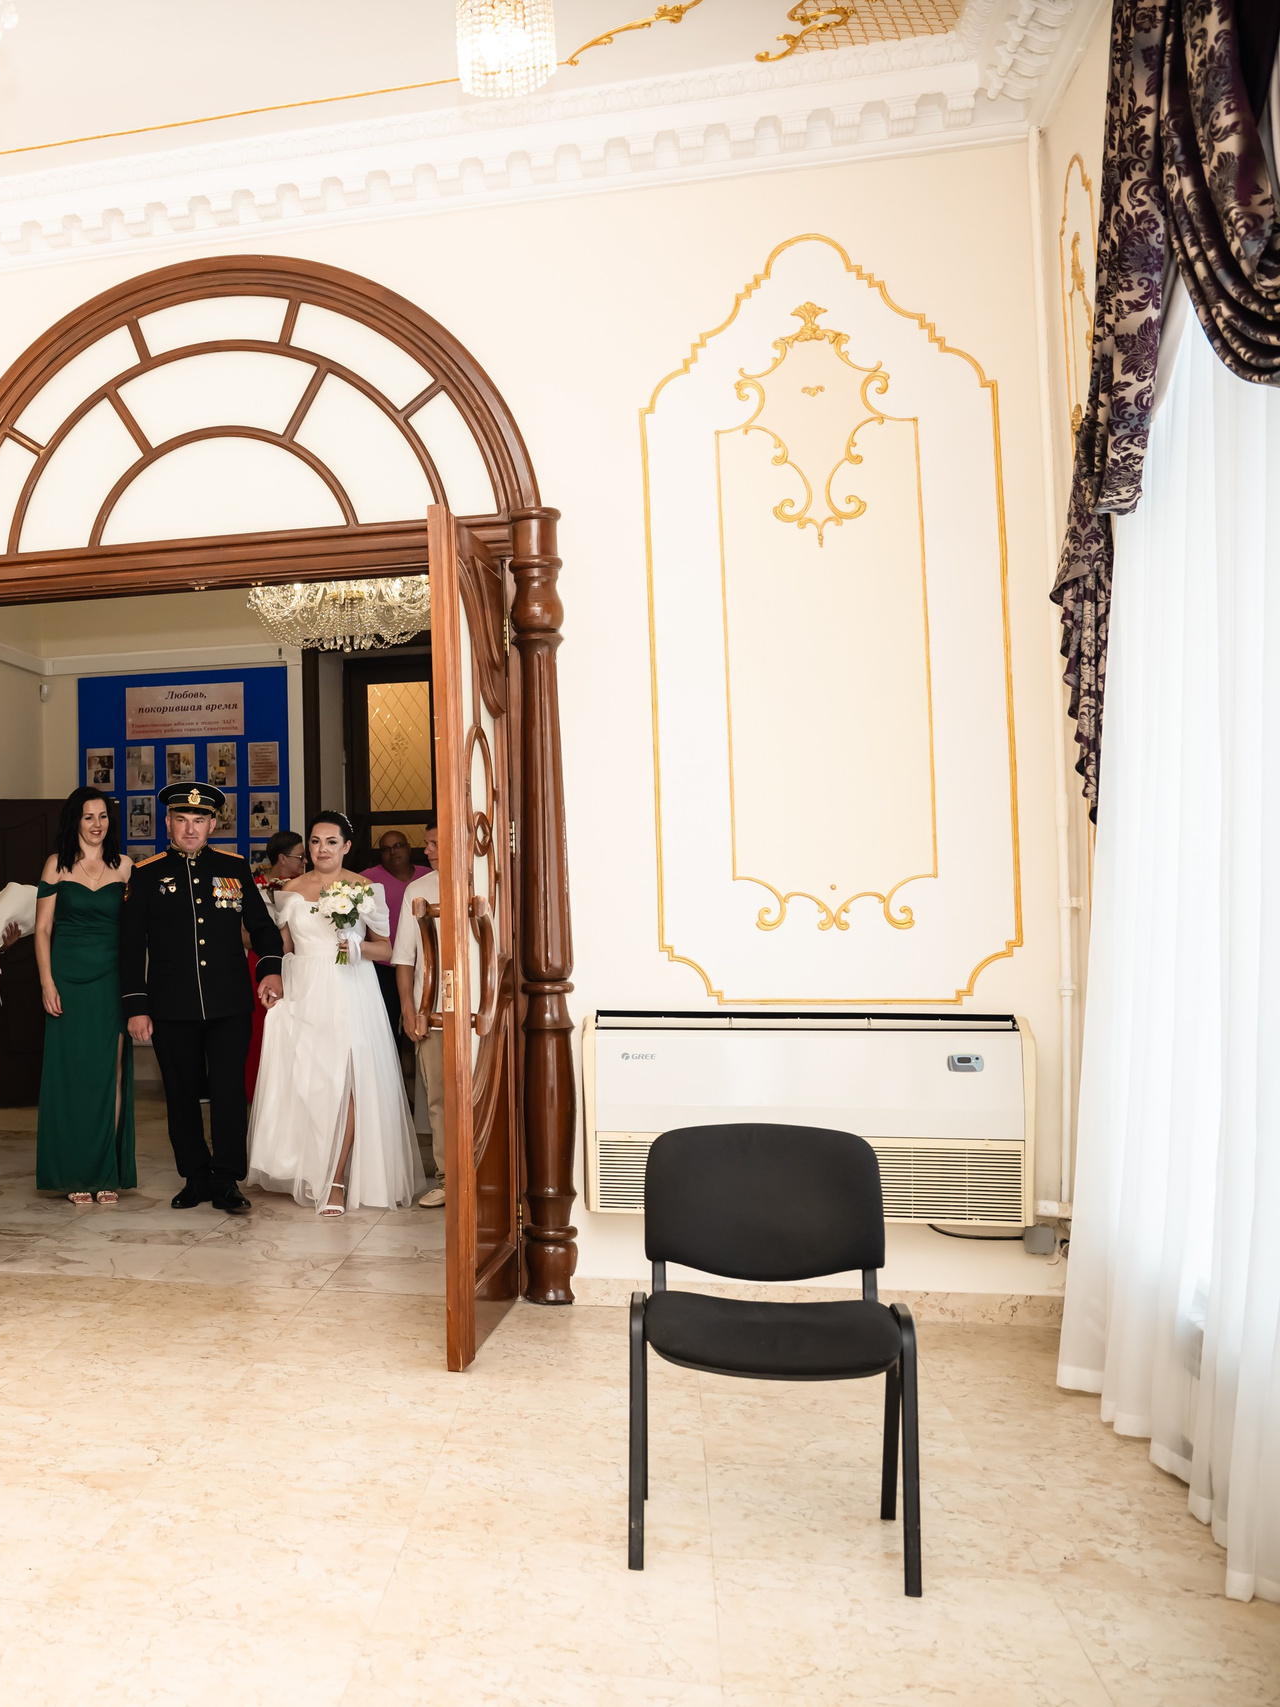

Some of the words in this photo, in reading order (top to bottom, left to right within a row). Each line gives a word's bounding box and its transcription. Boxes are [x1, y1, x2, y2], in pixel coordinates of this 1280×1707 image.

[165, 690, 207, 700] Любовь,
[138, 703, 202, 714] покорившая
[205, 702, 238, 712] время
